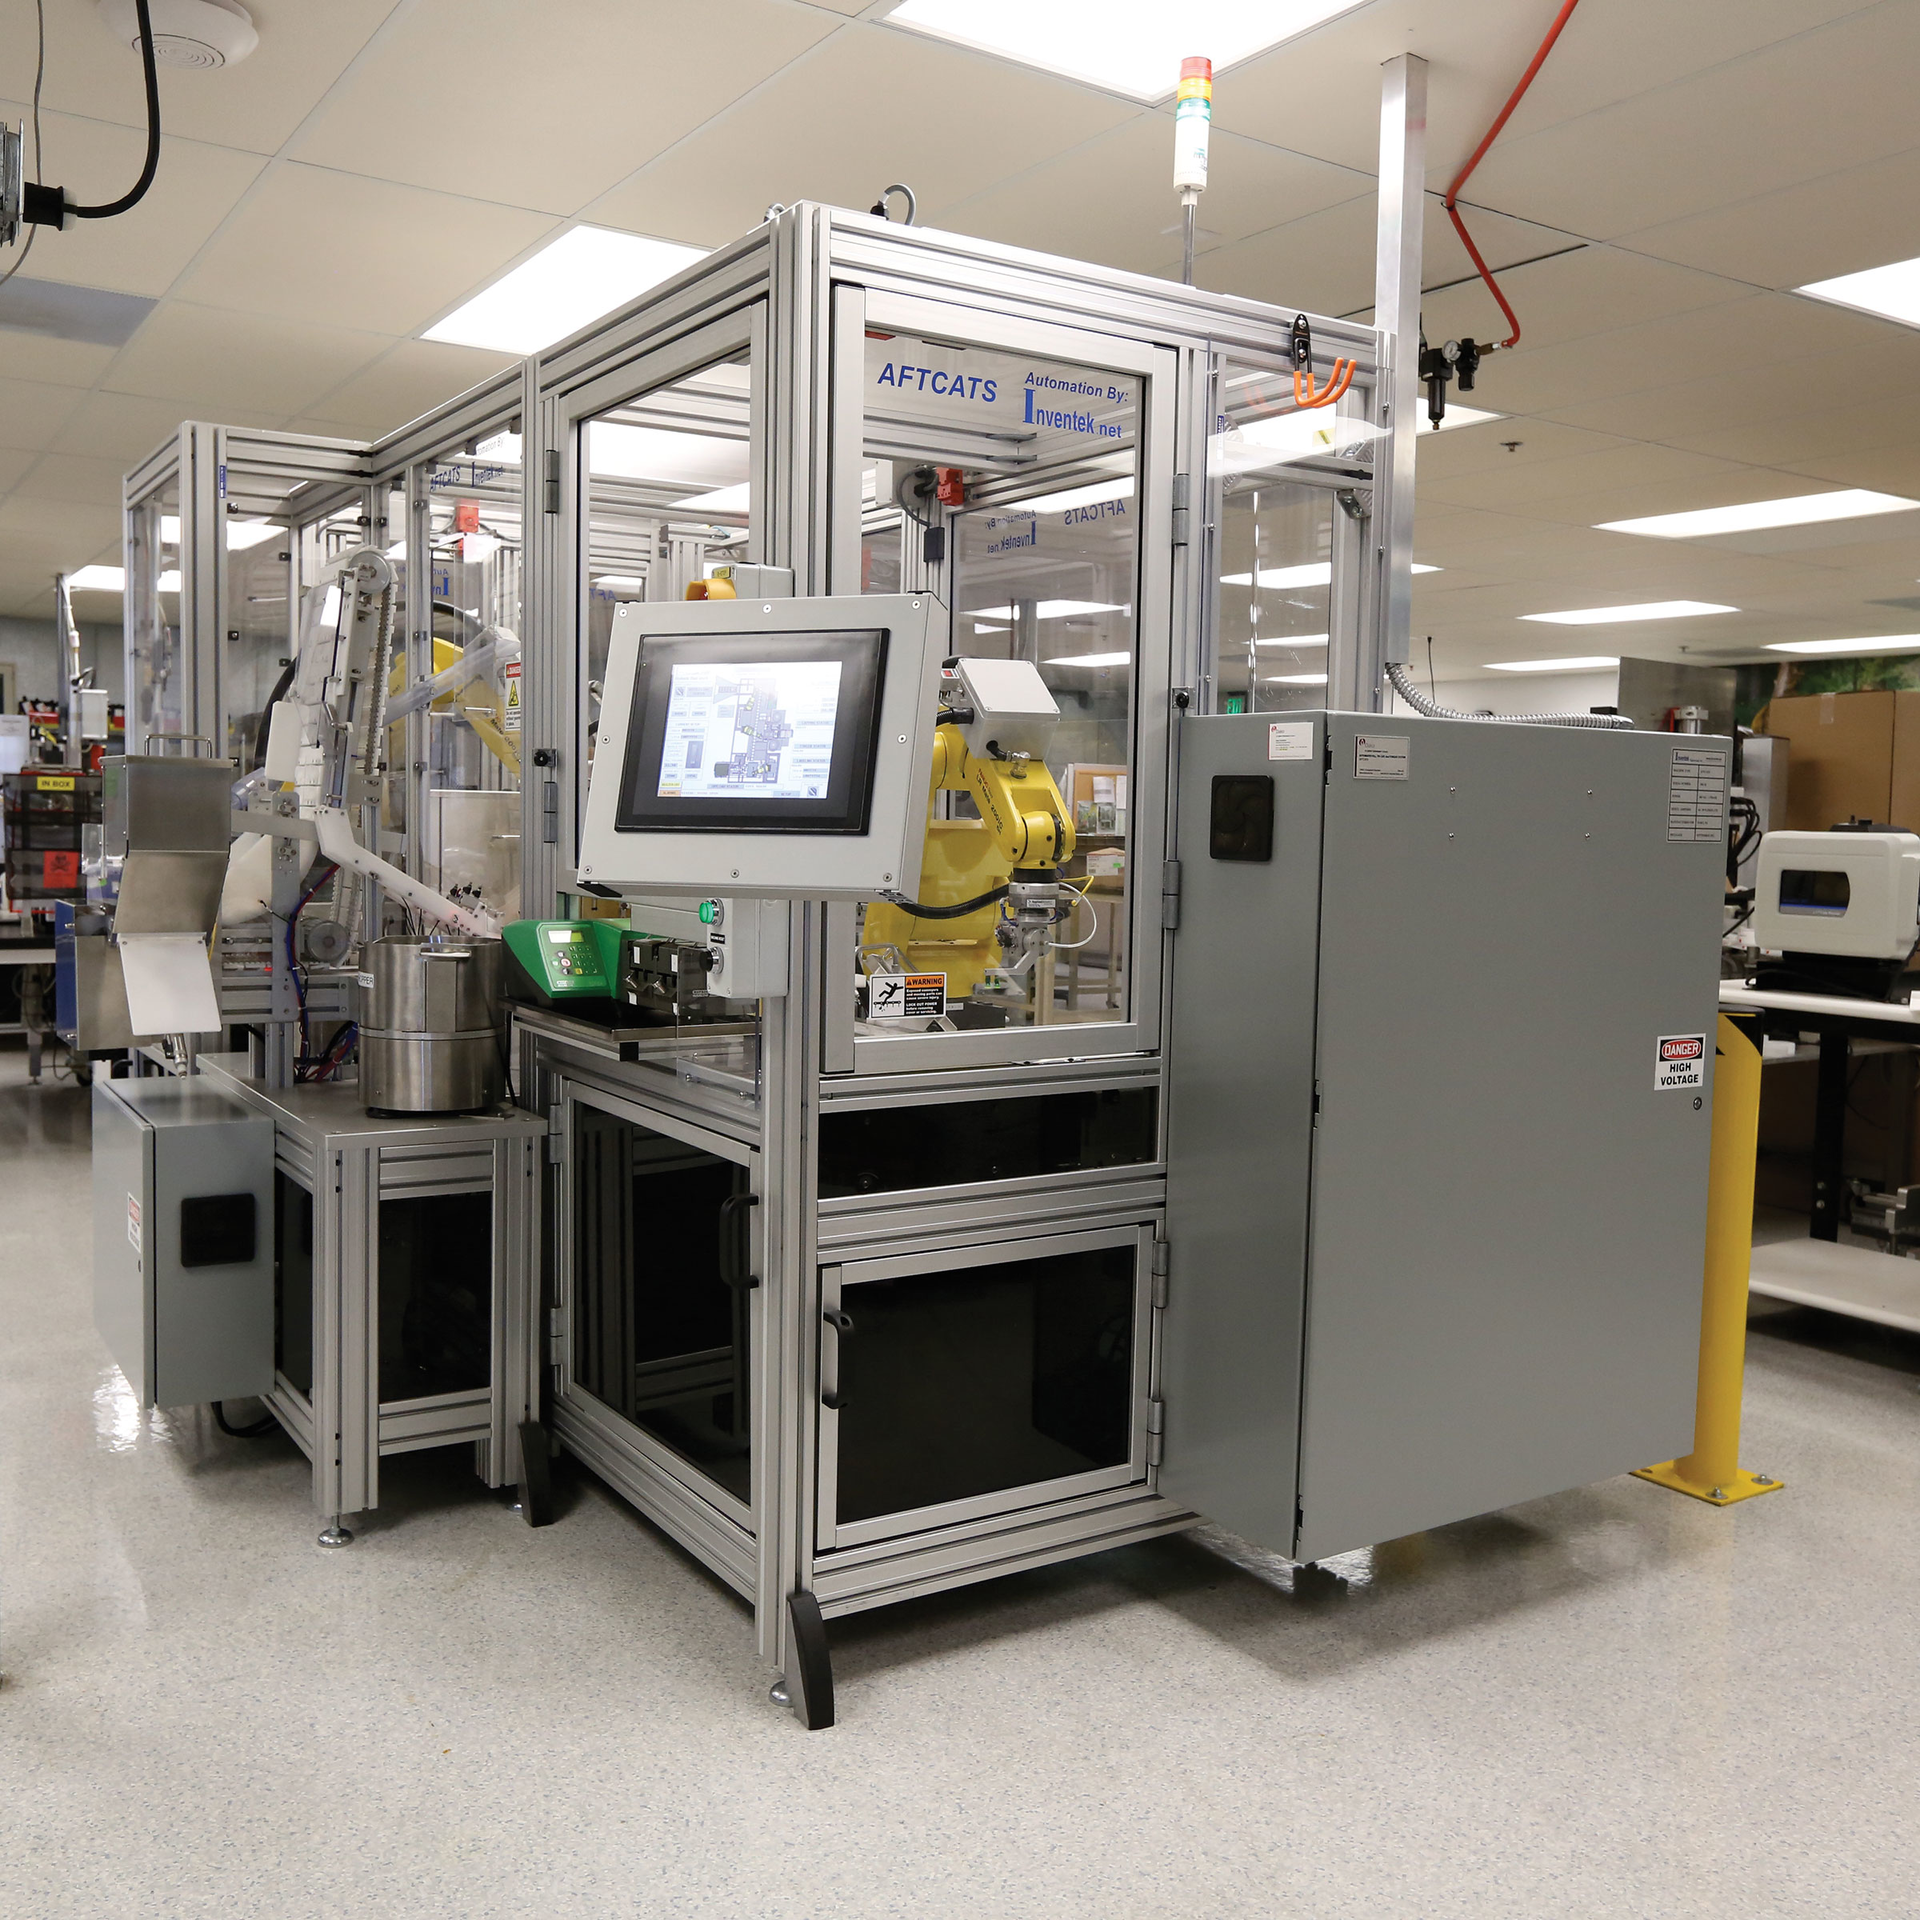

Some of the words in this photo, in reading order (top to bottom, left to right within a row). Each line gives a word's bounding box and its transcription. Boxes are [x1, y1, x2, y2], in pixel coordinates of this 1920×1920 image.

[877, 363, 998, 402] AFTCATS
[1024, 371, 1103, 398] Automation
[1106, 386, 1130, 404] By:
[52, 780, 71, 788] BOX
[1664, 1042, 1699, 1056] DANGER
[1669, 1062, 1691, 1073] HIGH
[1660, 1074, 1699, 1086] VOLTAGE
